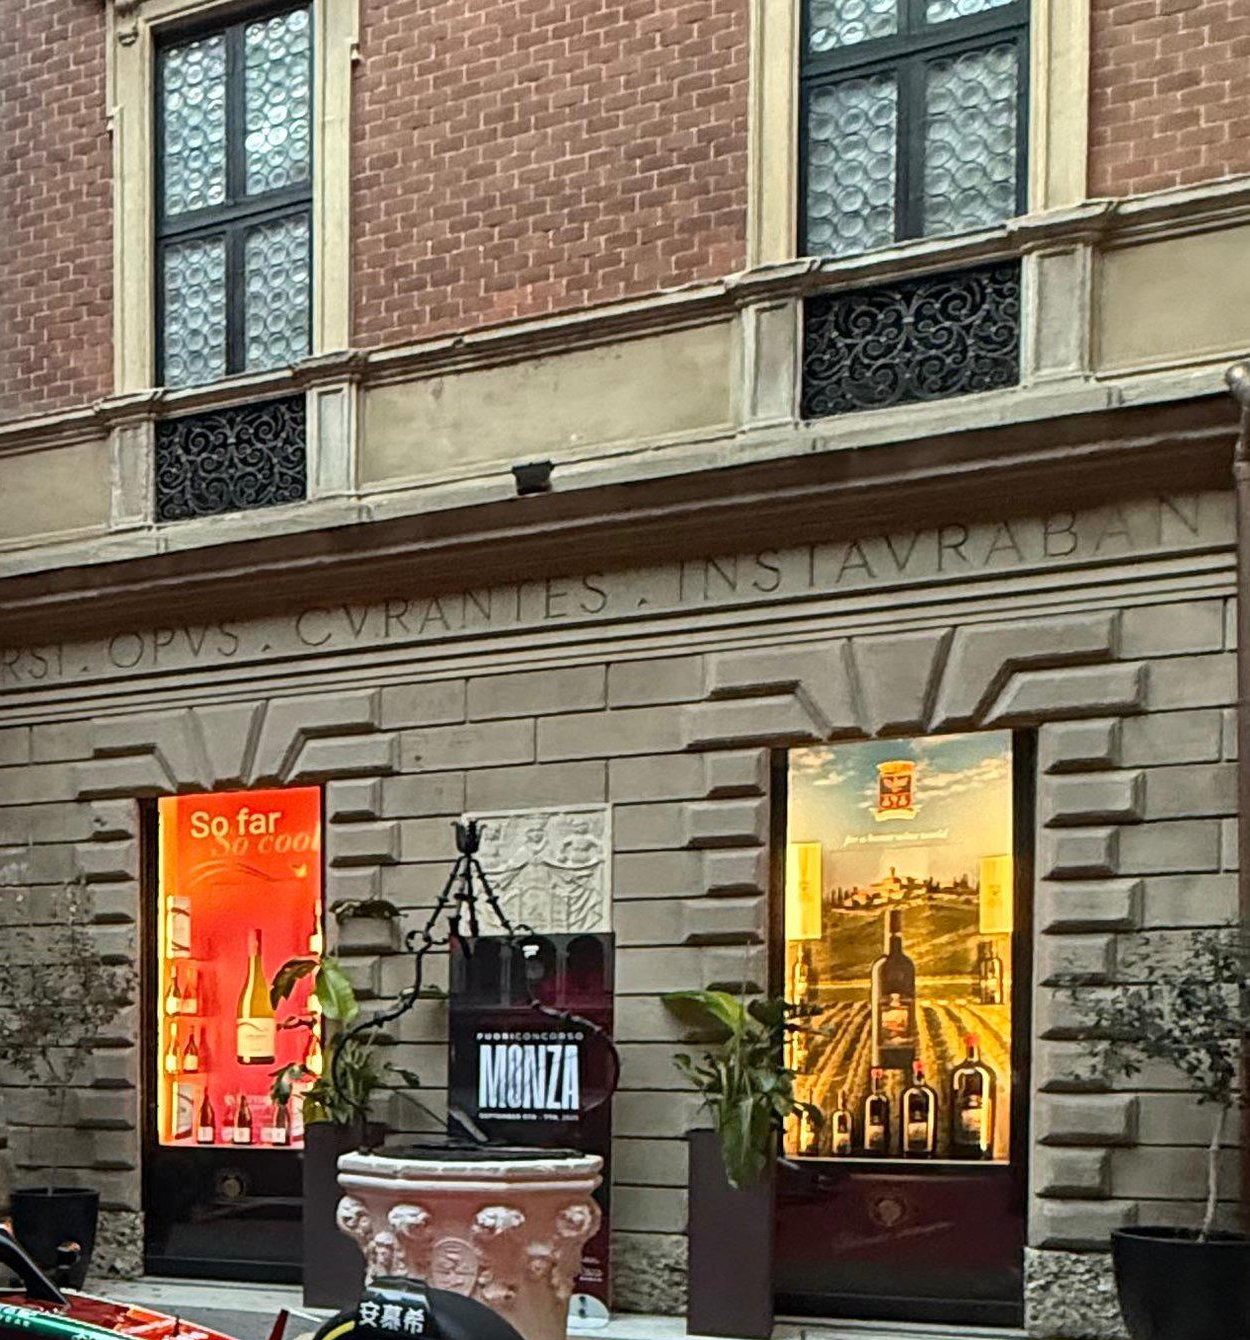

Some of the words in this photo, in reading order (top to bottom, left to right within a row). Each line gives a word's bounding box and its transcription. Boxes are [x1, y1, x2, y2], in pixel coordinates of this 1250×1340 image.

[107, 621, 240, 669] OPVS
[295, 572, 608, 648] CVRANTES
[678, 492, 1199, 602] INSTAVRABAN
[191, 811, 229, 838] So
[236, 807, 282, 835] far
[258, 820, 321, 854] cool
[478, 1044, 580, 1110] MONZA
[358, 1301, 426, 1335] 安慕希
